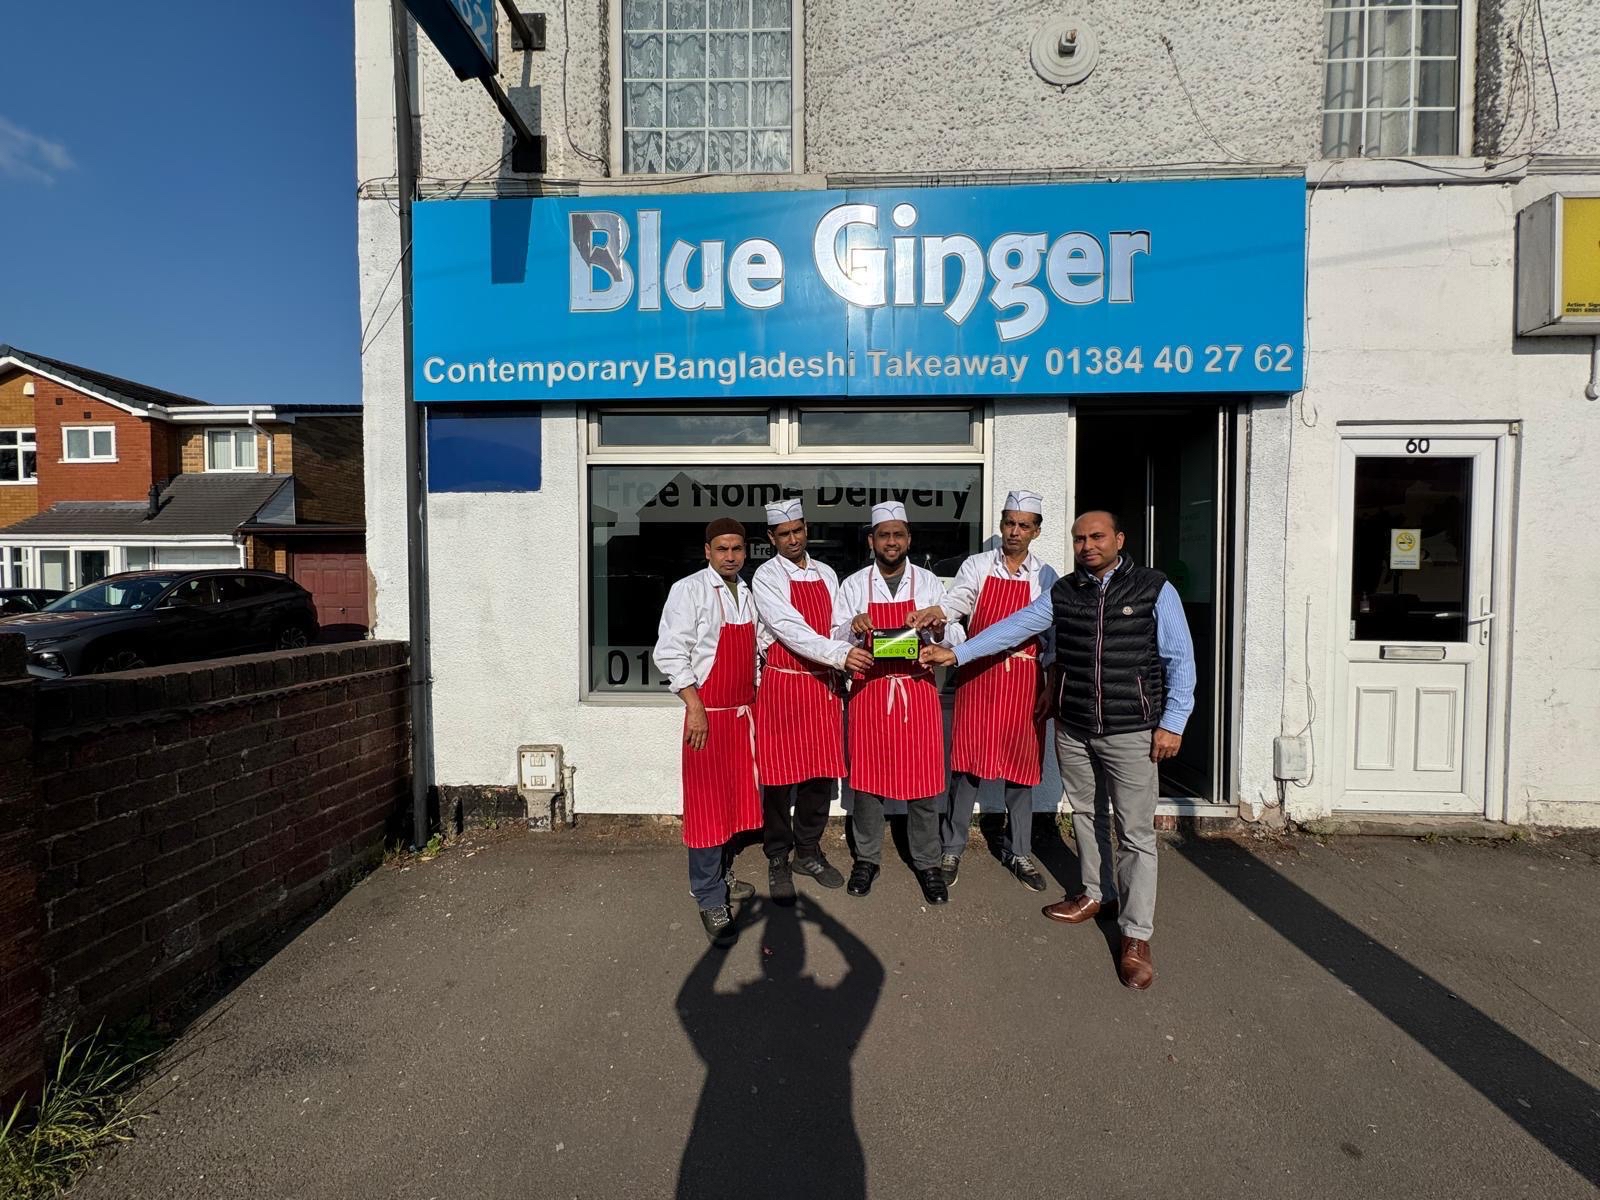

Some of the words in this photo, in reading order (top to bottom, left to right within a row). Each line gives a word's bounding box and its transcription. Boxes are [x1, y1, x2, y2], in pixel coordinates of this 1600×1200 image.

[569, 210, 784, 313] Blue
[813, 202, 1151, 341] Ginger
[422, 355, 650, 388] Contemporary
[653, 350, 857, 386] Bangladeshi
[866, 350, 1029, 383] Takeaway
[1045, 347, 1144, 377] 01384
[1153, 345, 1194, 375] 40
[1203, 344, 1243, 375] 27
[1253, 343, 1294, 373] 62
[1405, 438, 1430, 454] 60
[606, 471, 680, 507] Free
[691, 472, 804, 507] Home
[816, 469, 973, 520] Delivery
